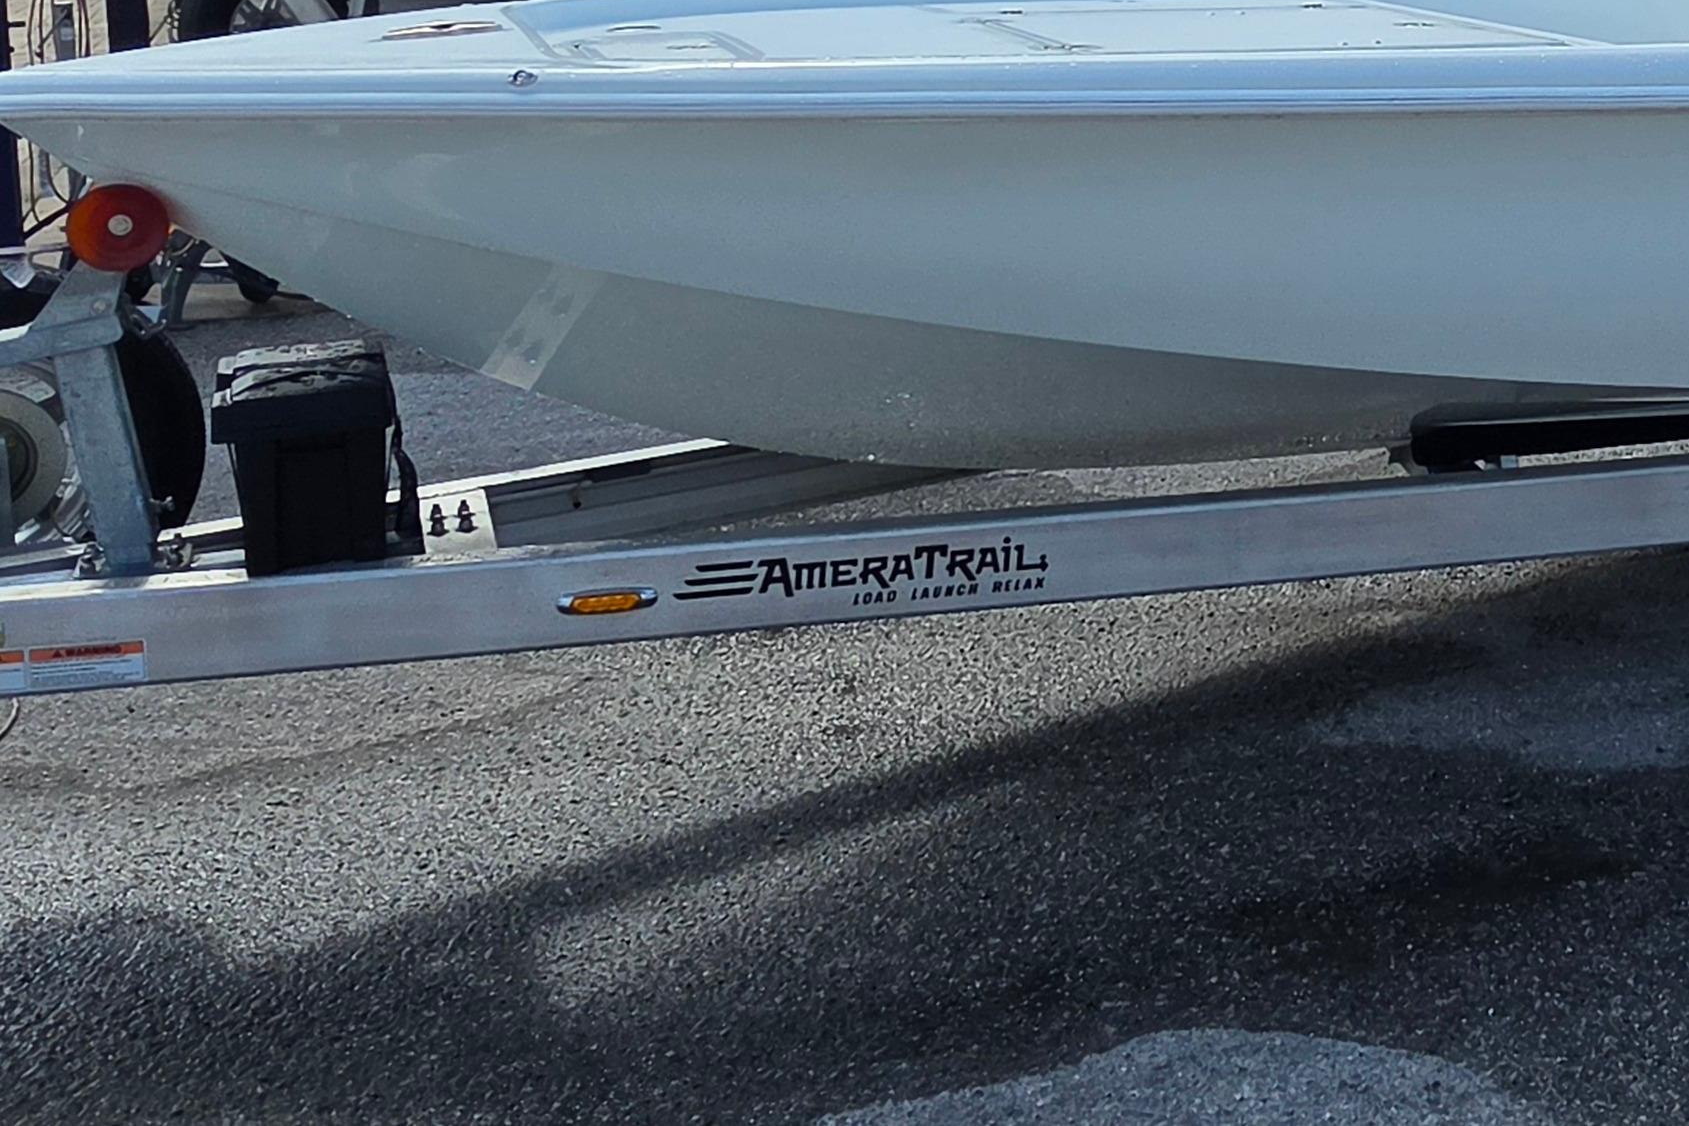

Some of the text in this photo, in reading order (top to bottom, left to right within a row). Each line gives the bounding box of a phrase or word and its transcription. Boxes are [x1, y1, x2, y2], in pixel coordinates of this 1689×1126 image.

[852, 577, 1046, 605] LOAD LAUNCH RELAX
